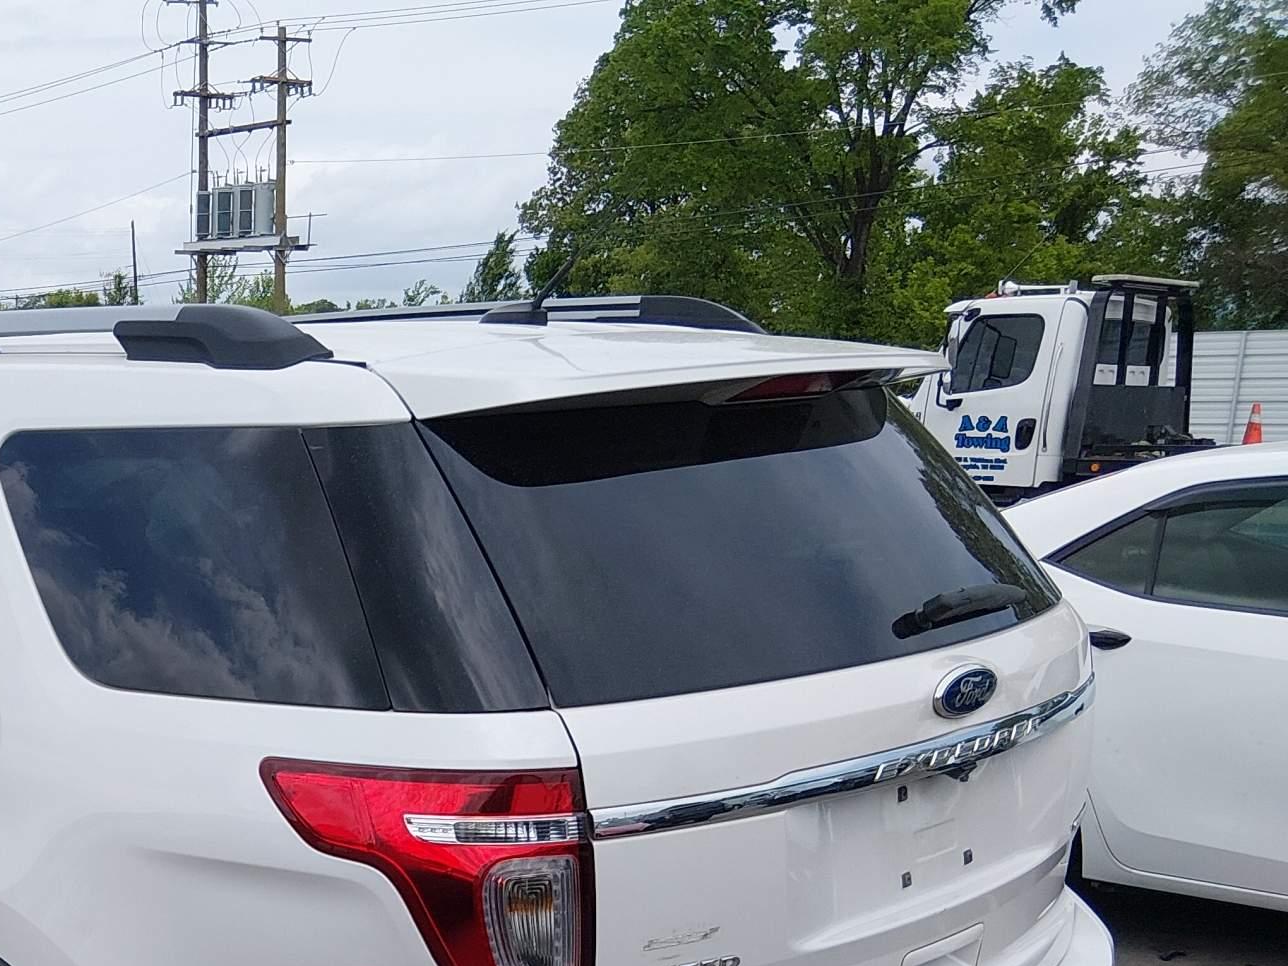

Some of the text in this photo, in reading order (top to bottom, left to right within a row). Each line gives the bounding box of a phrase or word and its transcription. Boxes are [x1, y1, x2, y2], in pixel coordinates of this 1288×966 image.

[958, 414, 1009, 434] A & A
[954, 433, 1011, 453] Towing
[954, 674, 992, 708] Ford
[872, 717, 1042, 783] EXPLORER
